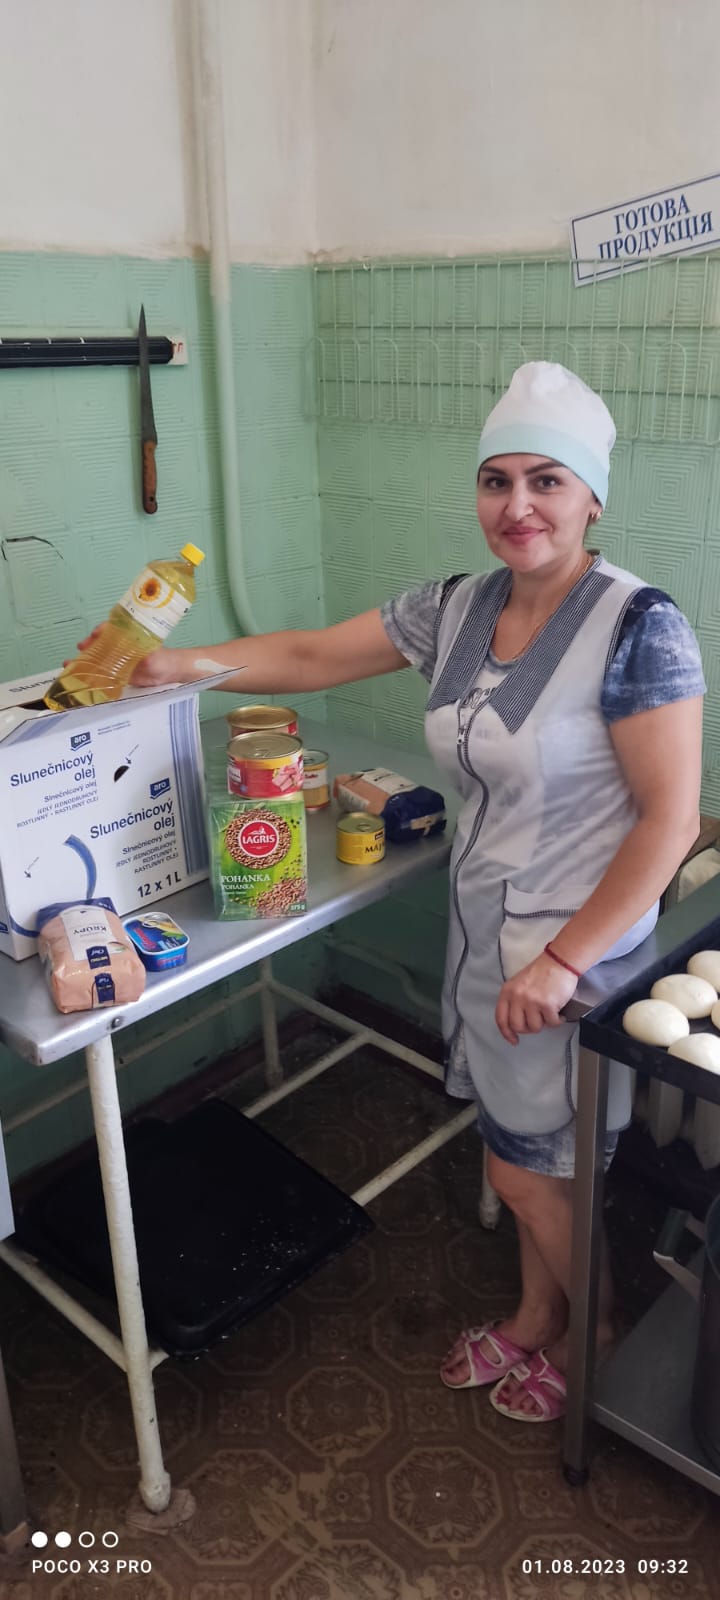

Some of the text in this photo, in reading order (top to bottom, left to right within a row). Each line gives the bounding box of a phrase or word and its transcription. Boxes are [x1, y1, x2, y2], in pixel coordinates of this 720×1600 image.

[613, 193, 690, 234] ГОТОВА
[598, 211, 713, 259] ПРОДУКЦІЯ
[10, 750, 93, 787] Slunečnicový
[74, 764, 96, 781] olej
[90, 798, 173, 839] Slunečnicový
[154, 812, 175, 831] olej
[242, 834, 276, 844] LAGRIS
[138, 871, 182, 898] 12 x 1 L
[221, 873, 271, 883] POHANKA
